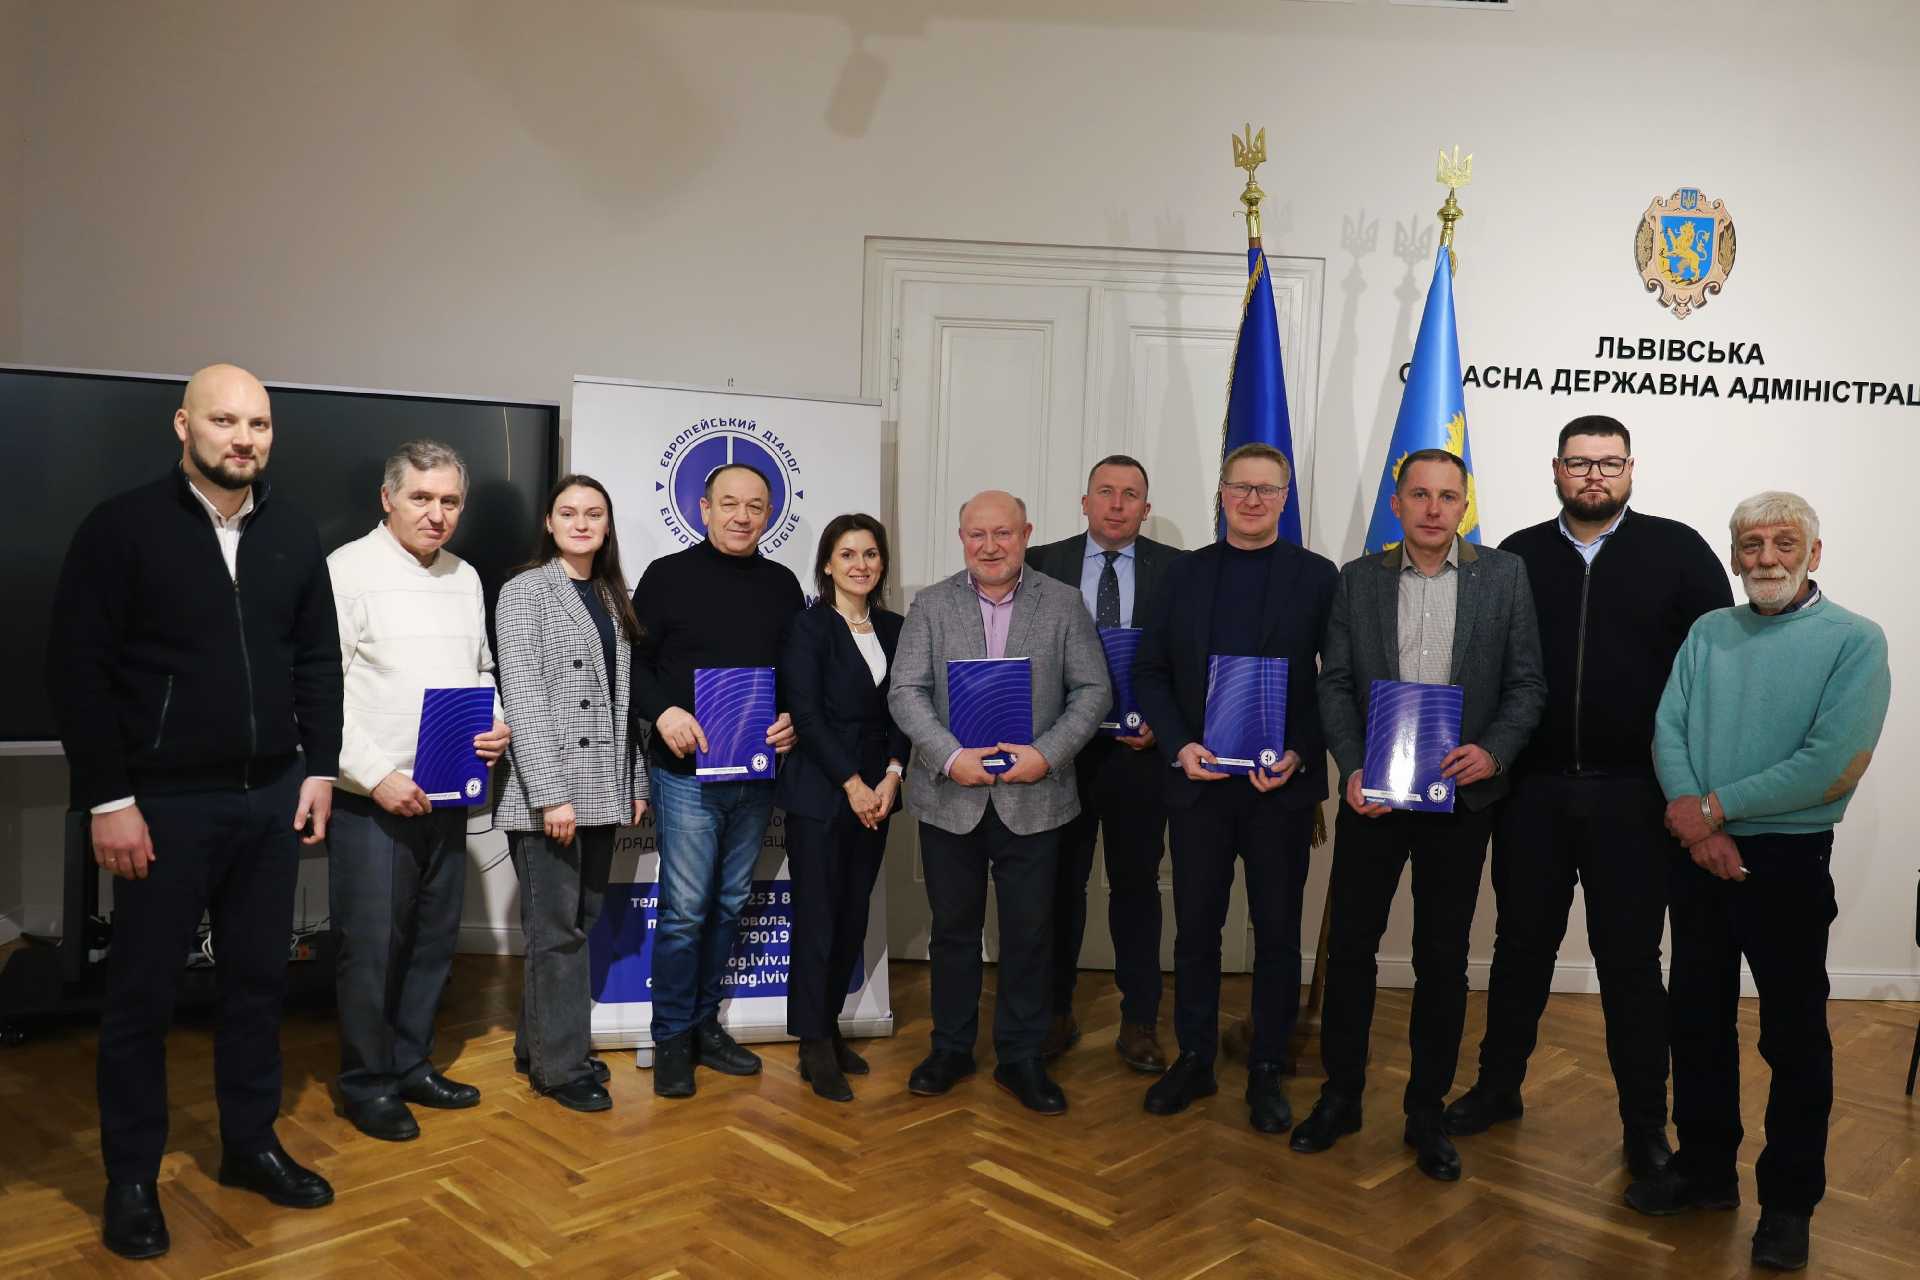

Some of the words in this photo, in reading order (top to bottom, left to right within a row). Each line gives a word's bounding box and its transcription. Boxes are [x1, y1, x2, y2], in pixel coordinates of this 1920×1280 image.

[1595, 336, 1765, 365] ЛЬВІВСЬКА
[1399, 362, 1543, 390] АСНА
[1550, 368, 1719, 397] ДЕРЖАВНА
[762, 430, 801, 474] ДІАЛОГ
[660, 507, 697, 549] EUROP
[758, 513, 801, 556] LOGUE
[737, 915, 791, 928] овола,
[739, 930, 790, 944] 79019
[726, 952, 791, 970] og.lviv.u
[720, 970, 789, 988] alog.lviv
